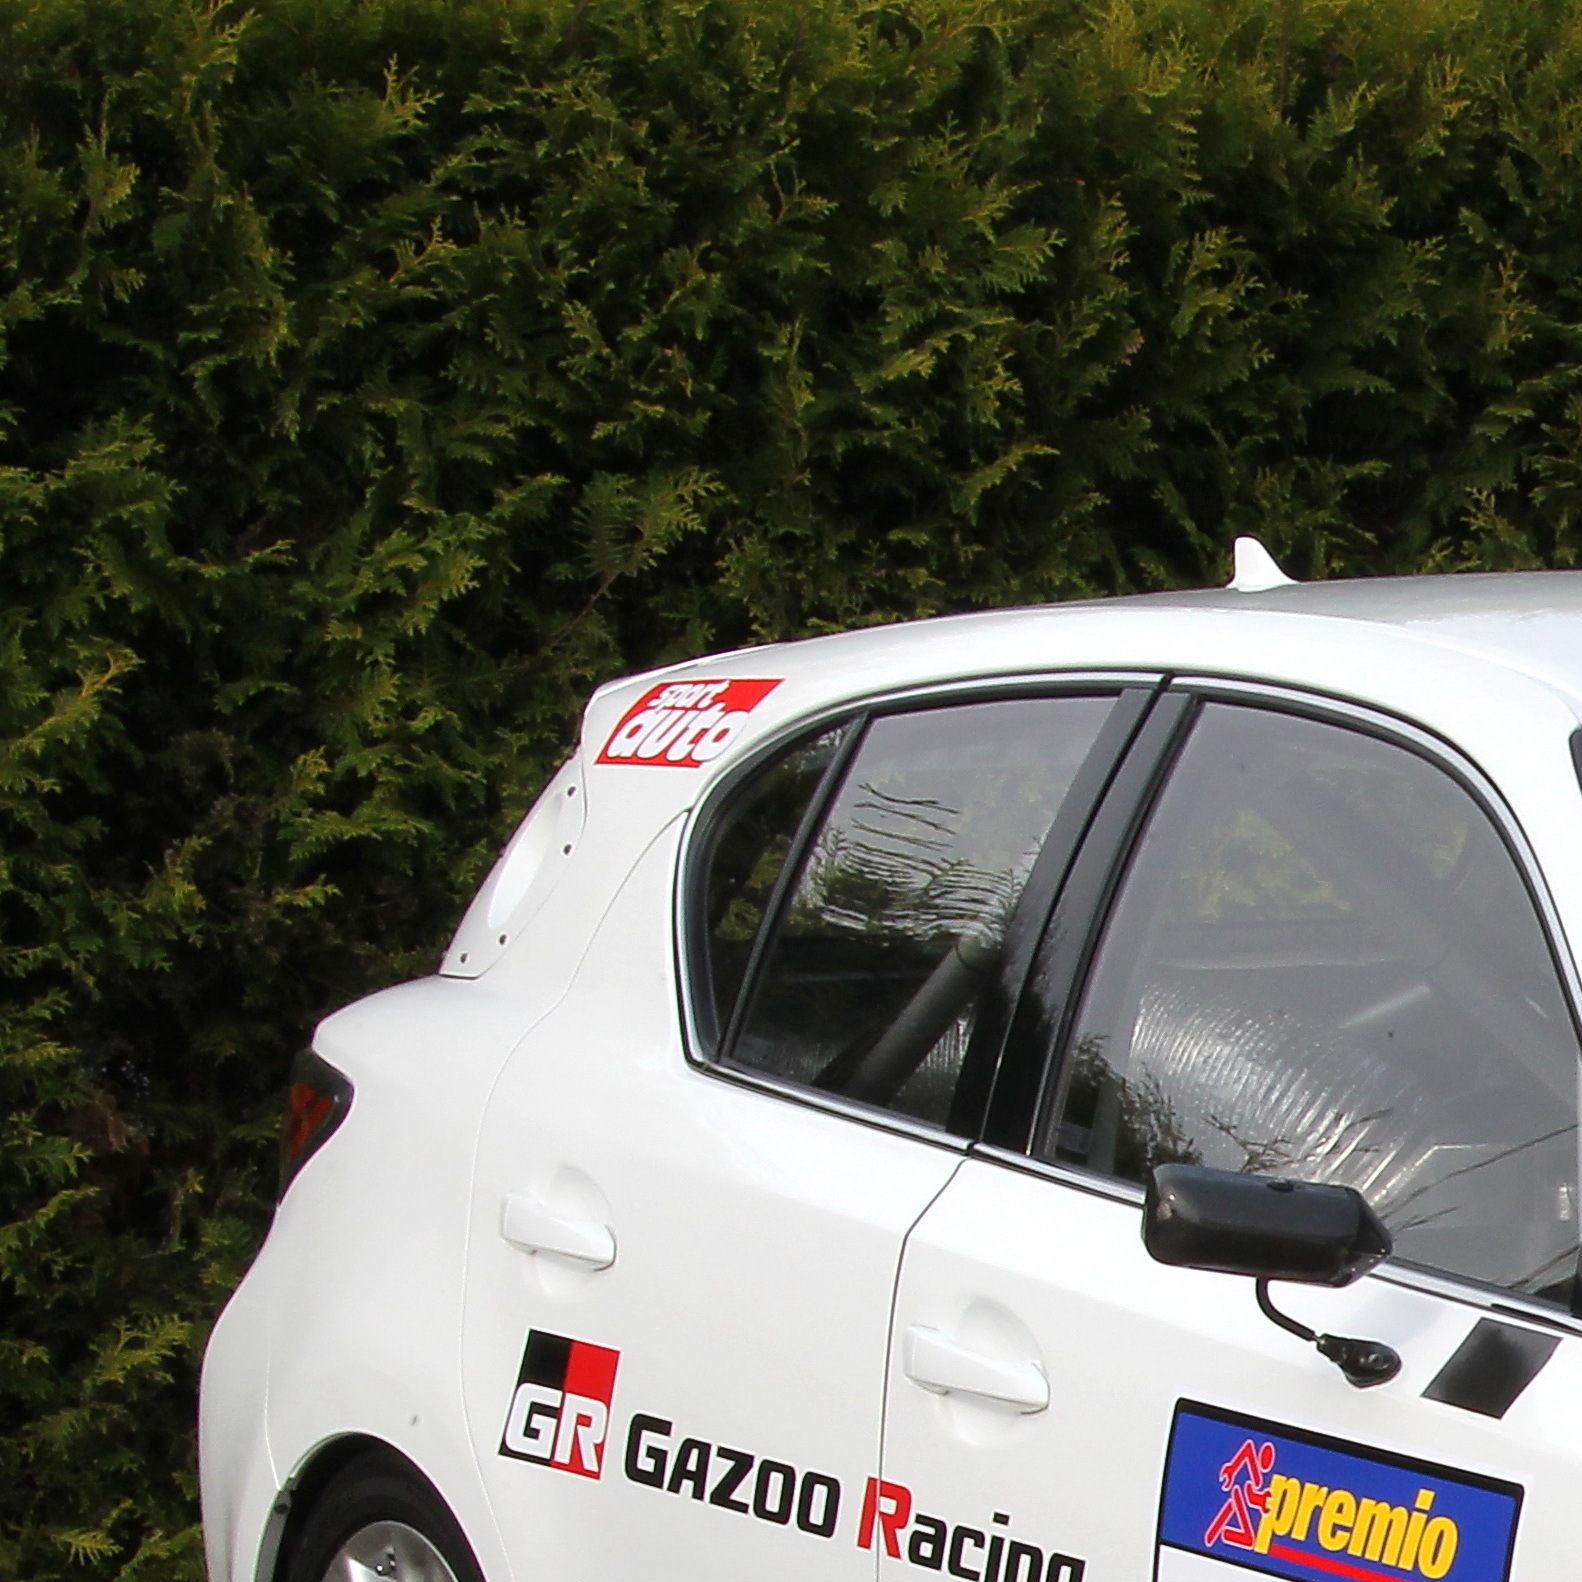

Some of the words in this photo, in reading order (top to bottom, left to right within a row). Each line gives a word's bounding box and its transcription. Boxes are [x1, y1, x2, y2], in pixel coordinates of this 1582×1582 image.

[606, 703, 750, 763] auto
[649, 680, 731, 713] sport
[506, 1382, 608, 1472] GR
[1255, 1473, 1460, 1580] premio
